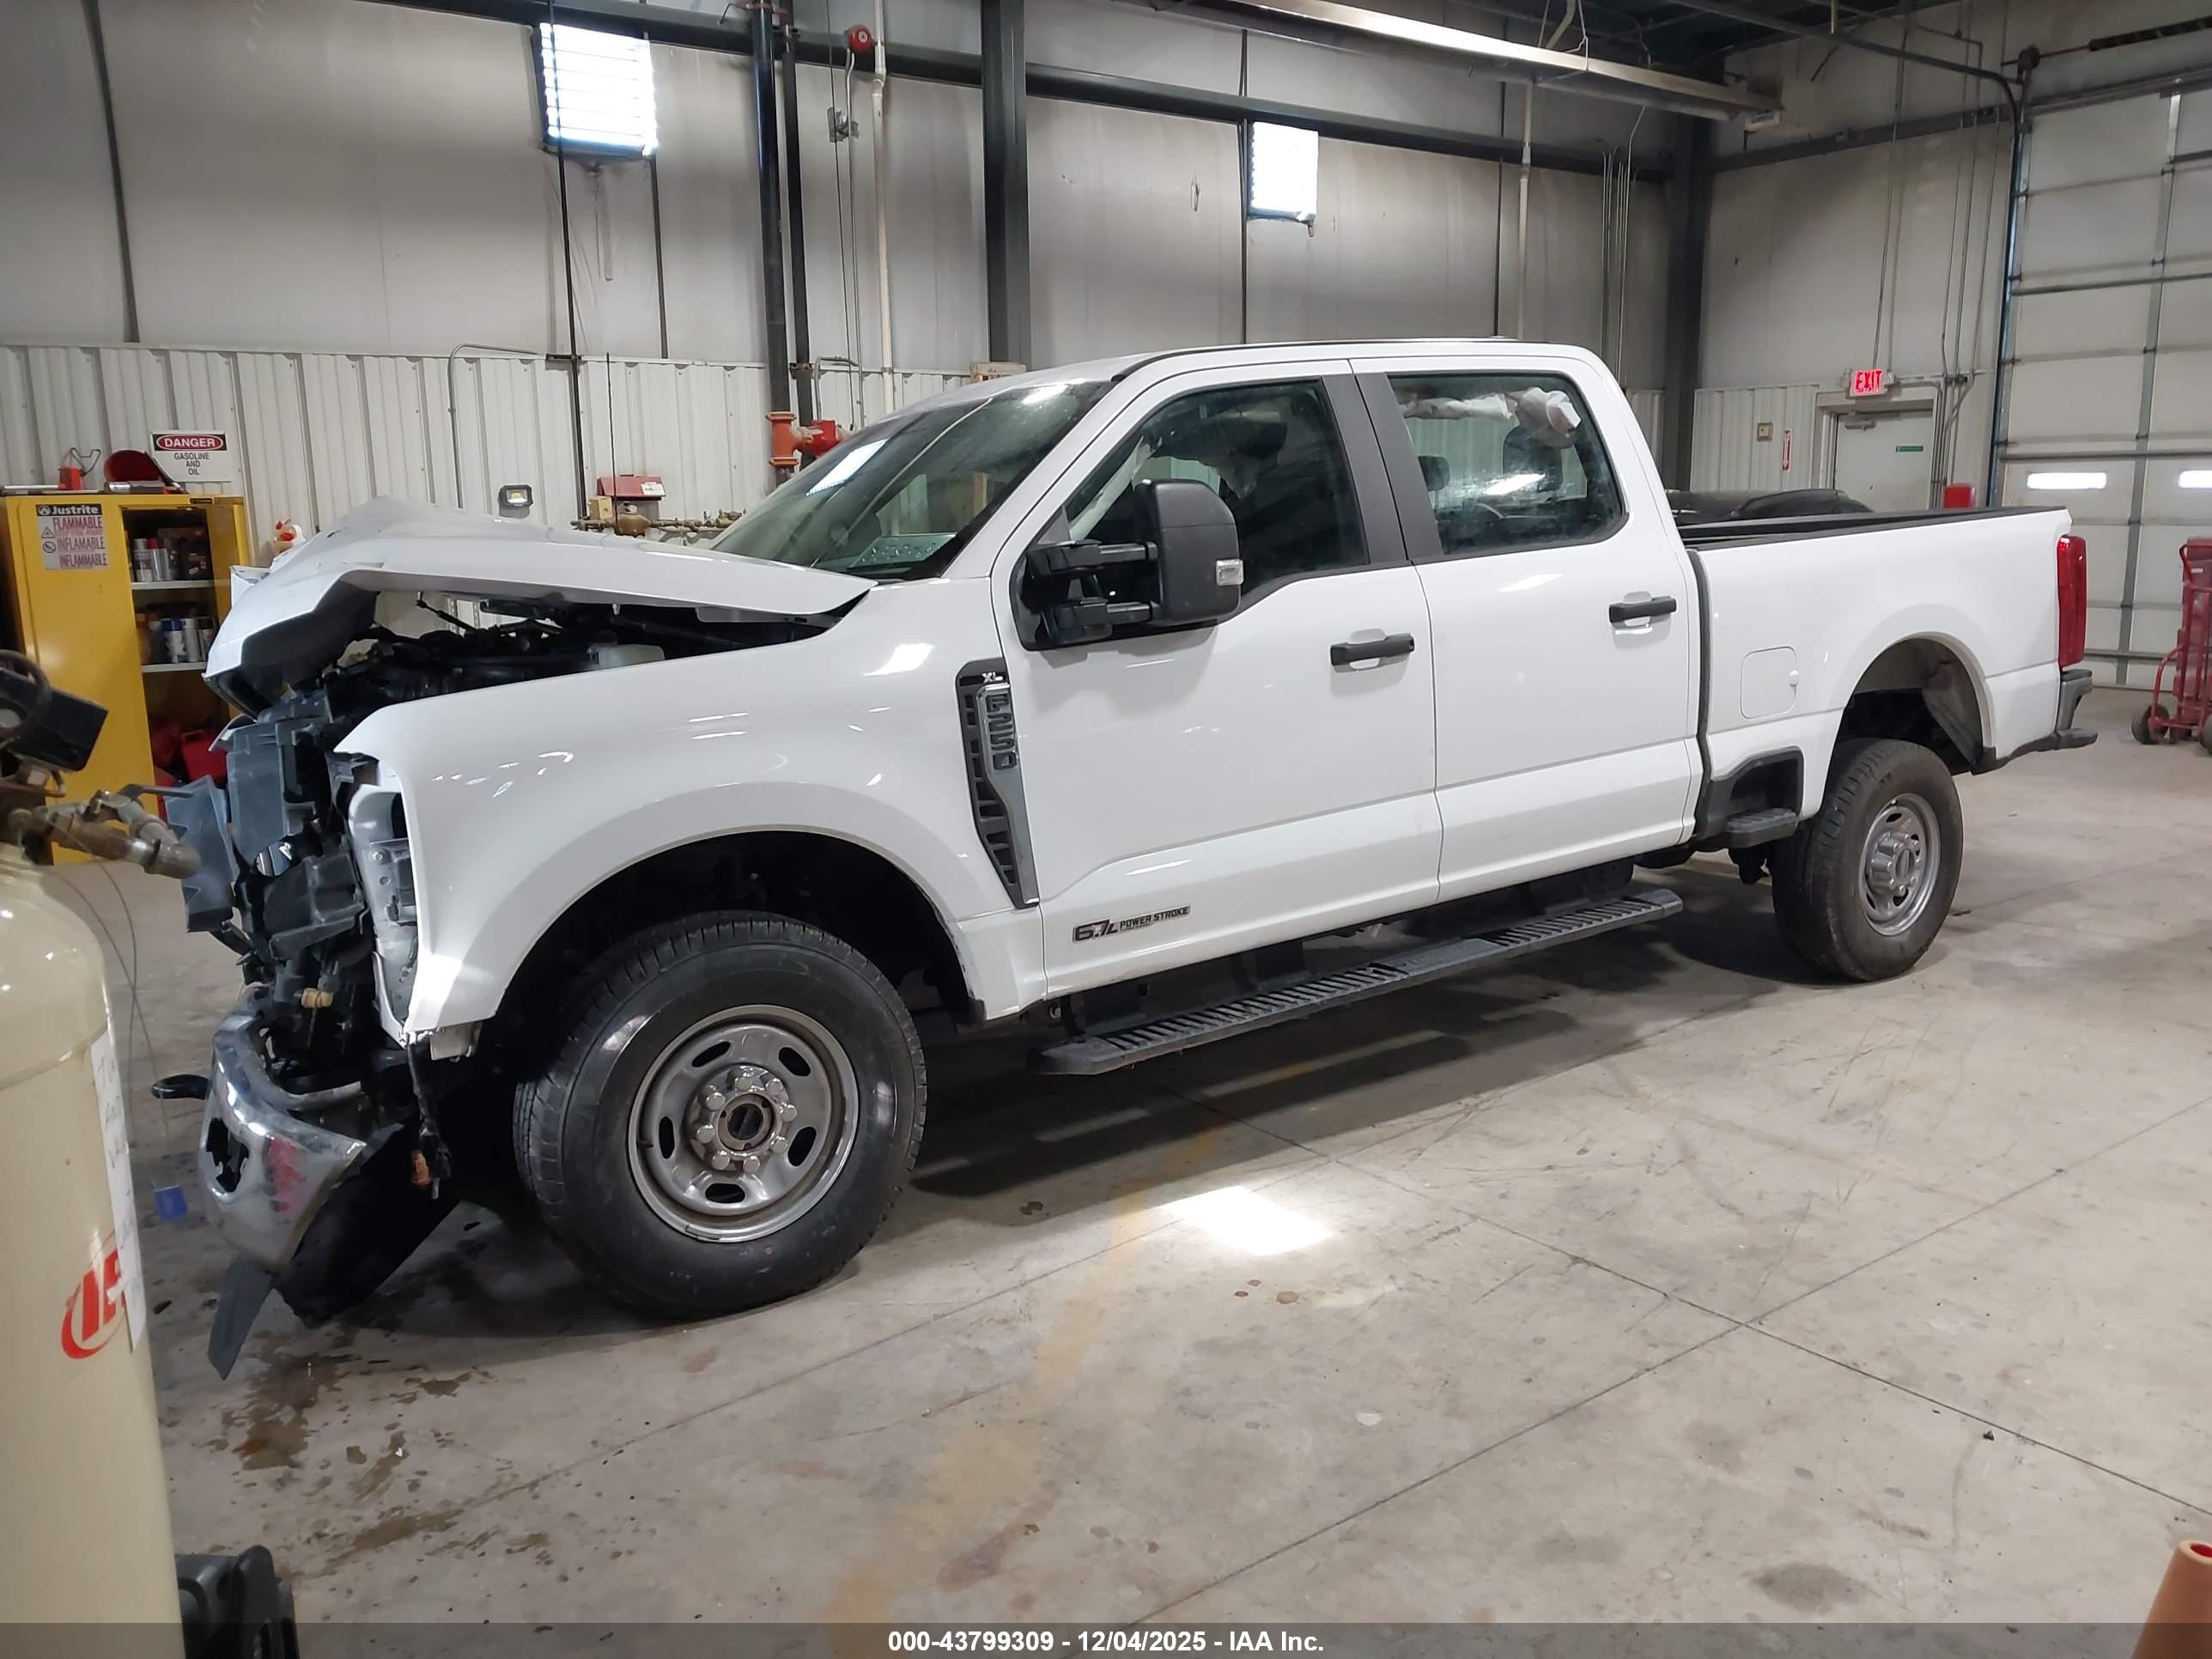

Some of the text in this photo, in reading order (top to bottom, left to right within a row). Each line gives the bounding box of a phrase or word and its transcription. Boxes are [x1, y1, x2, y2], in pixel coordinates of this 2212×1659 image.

[1855, 370, 1882, 392] EXIT
[164, 438, 216, 447] DANGER
[173, 452, 210, 460] GASOLINE
[52, 505, 99, 515] Justrite
[53, 516, 102, 530] FLAMMABLE
[981, 672, 1003, 684] XL
[1073, 919, 1118, 941] 6.7L
[1119, 915, 1152, 928] POWER
[1153, 906, 1189, 921] STROKE
